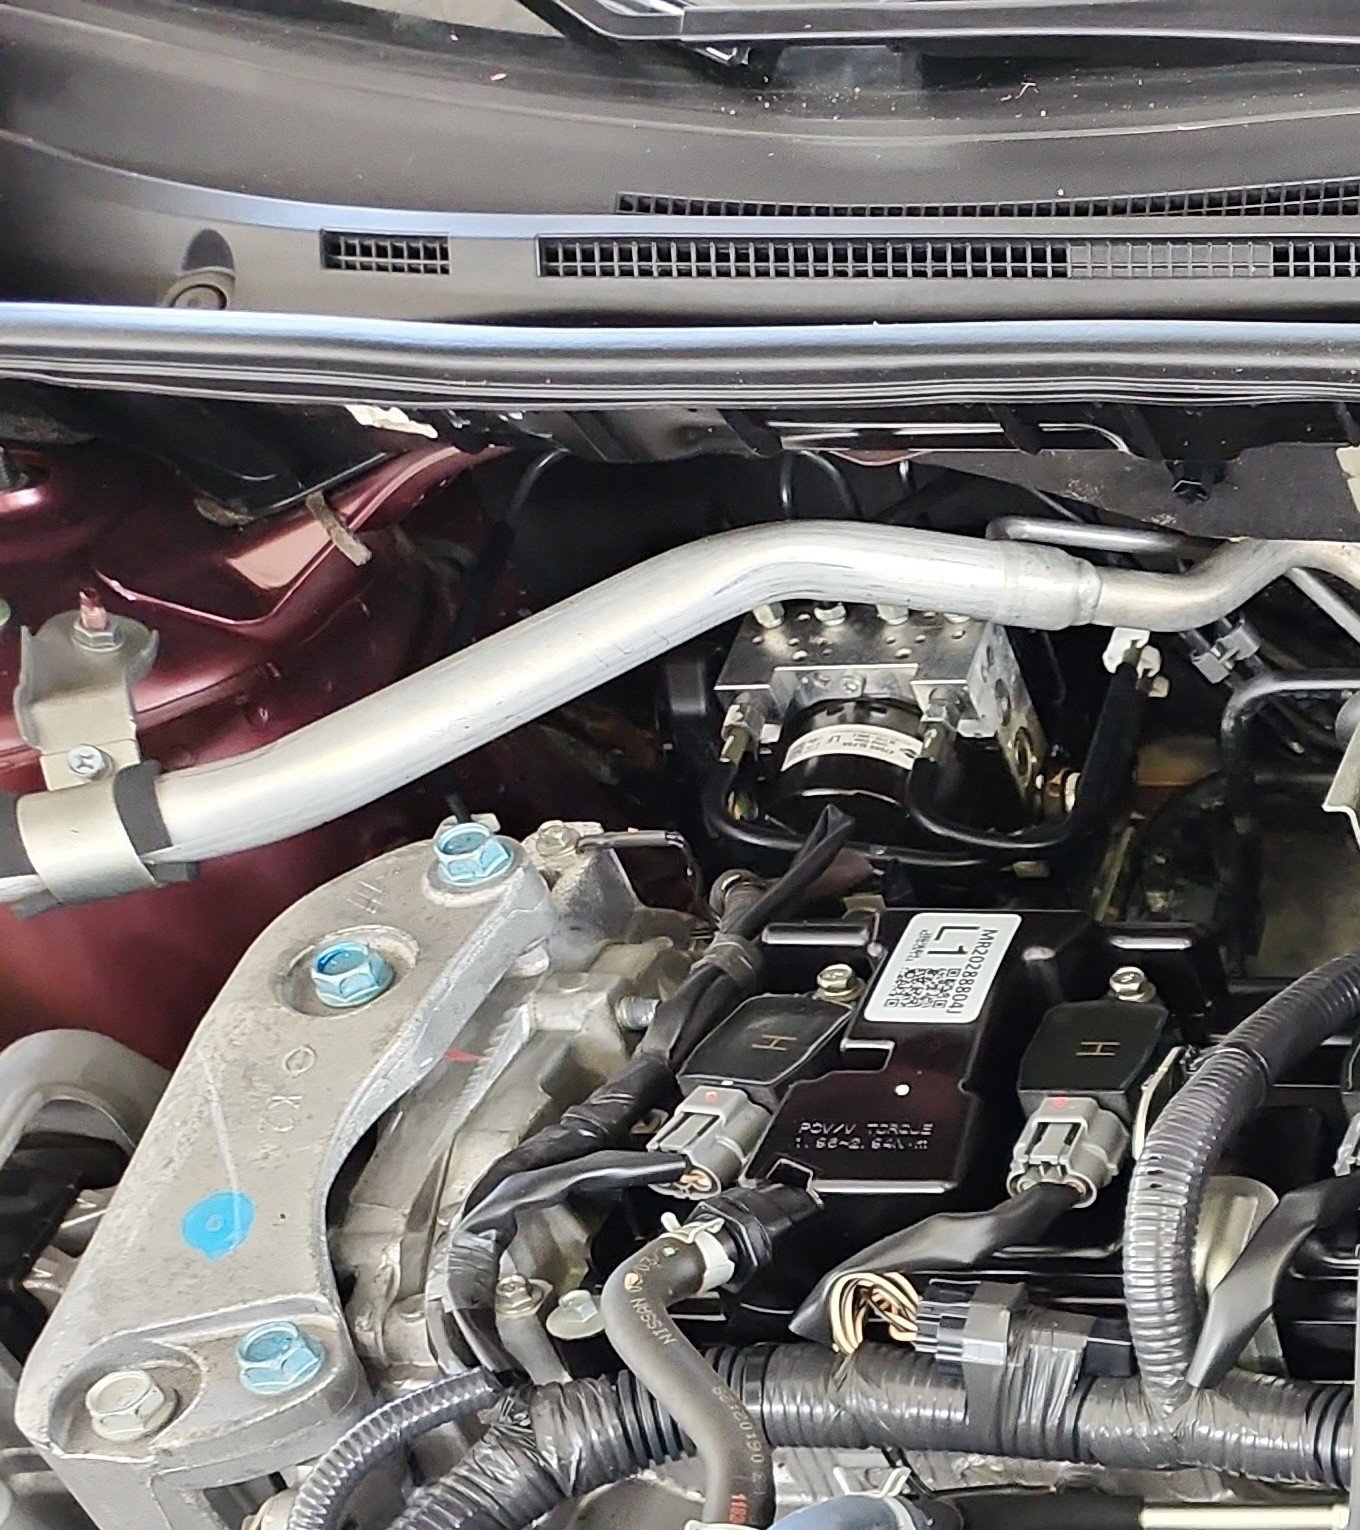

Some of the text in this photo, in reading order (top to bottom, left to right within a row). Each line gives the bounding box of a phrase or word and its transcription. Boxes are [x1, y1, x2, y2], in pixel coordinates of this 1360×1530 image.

[926, 925, 981, 956] L1
[945, 929, 999, 1015] MR20288804J
[867, 1123, 934, 1136] TORQUE
[631, 1297, 678, 1346] NISSAN
